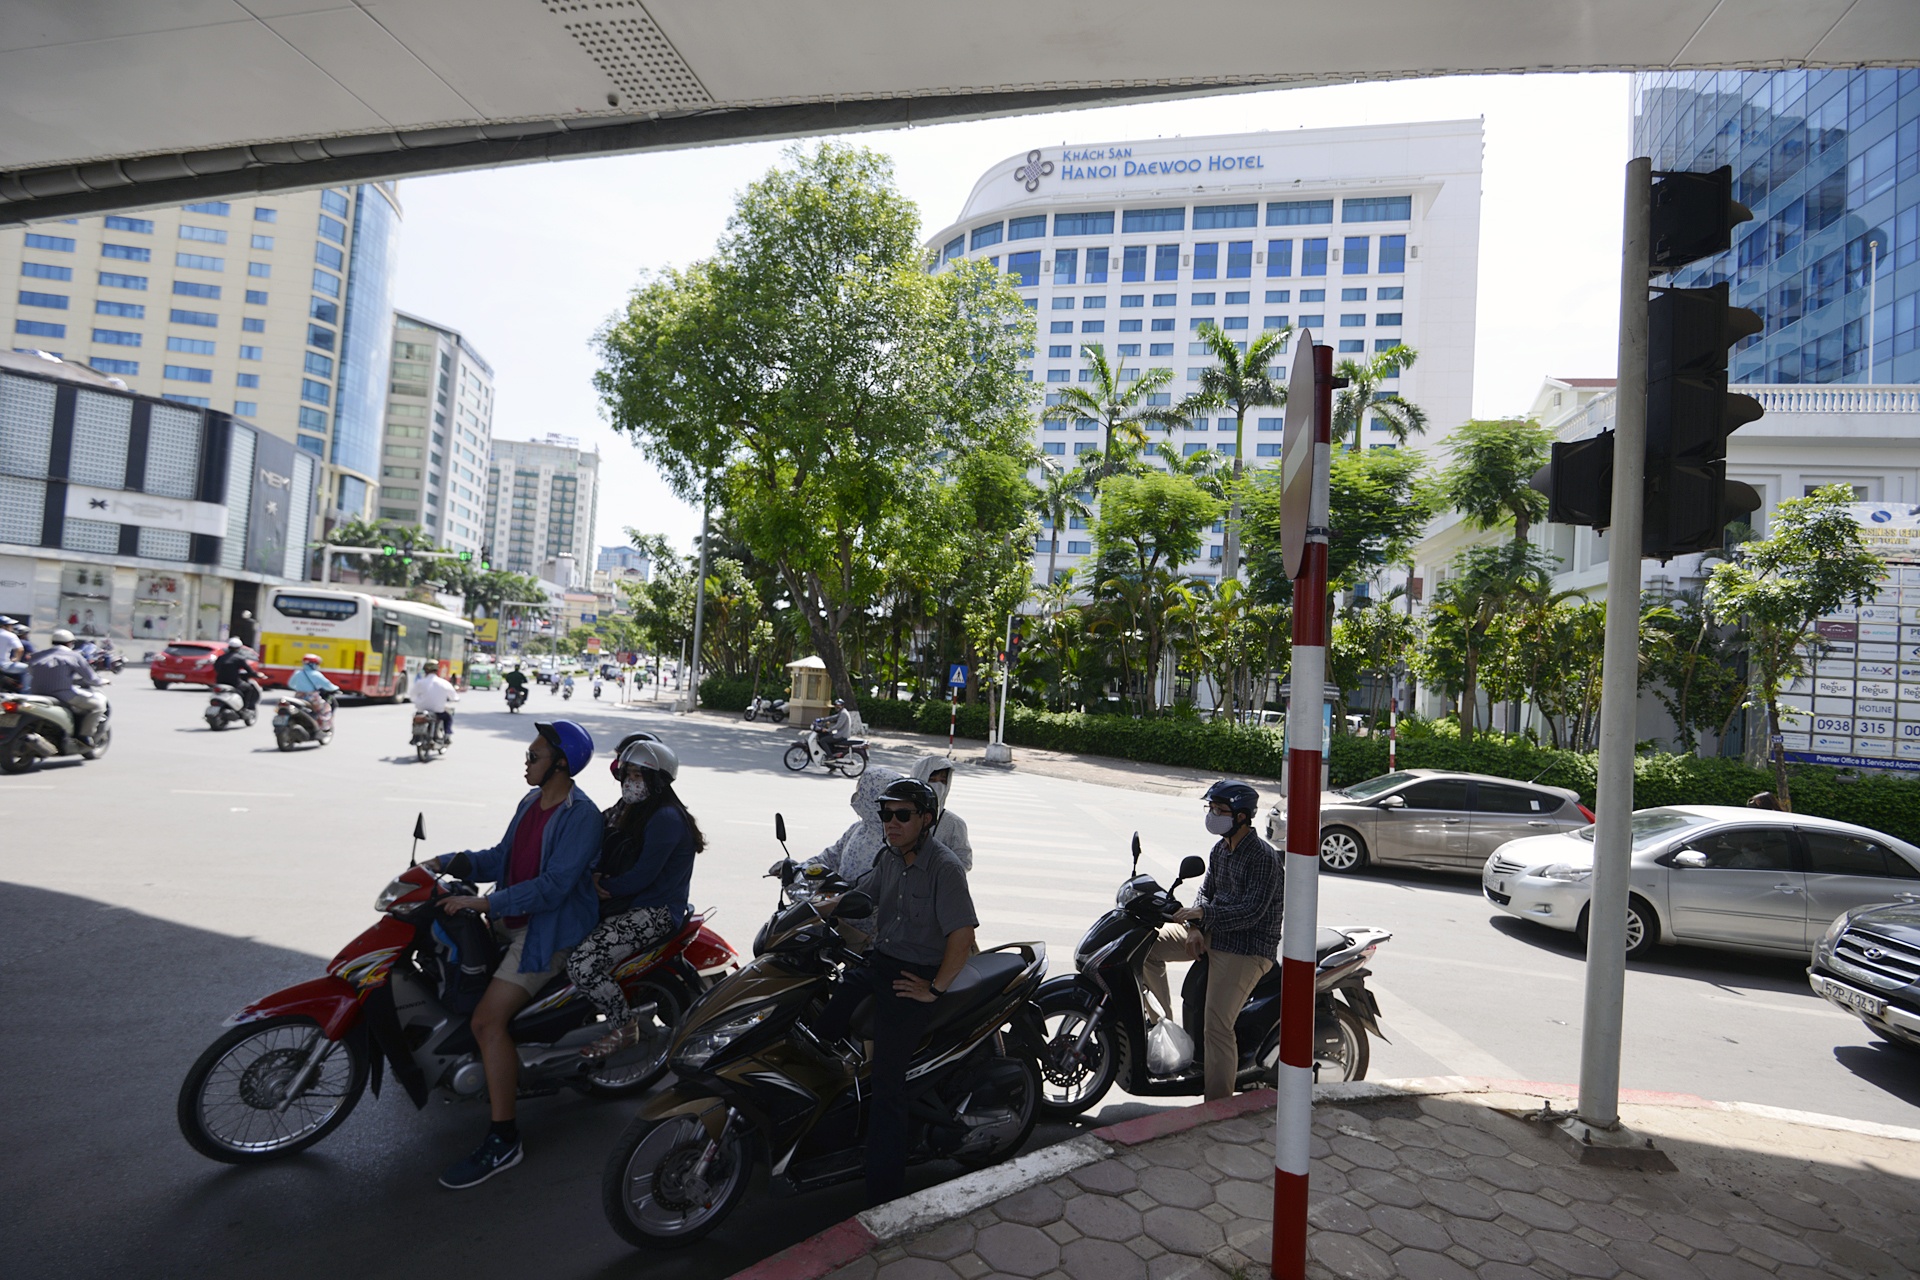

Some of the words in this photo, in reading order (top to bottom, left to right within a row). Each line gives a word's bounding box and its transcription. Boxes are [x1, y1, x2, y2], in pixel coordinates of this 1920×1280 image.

[1061, 165, 1117, 181] HANOI
[1123, 159, 1202, 177] DAEWOO
[1208, 155, 1265, 172] HOTEL
[0, 580, 28, 589] EM
[1820, 682, 1847, 694] Regus
[1861, 685, 1889, 697] Regus
[1858, 704, 1893, 714] HOTLINE
[1817, 719, 1850, 732] 0938
[1860, 722, 1886, 734] 315
[1904, 725, 1920, 737] 00
[1816, 755, 1840, 764] Premier
[1840, 757, 1860, 766] Office
[1866, 759, 1895, 768] Serviced
